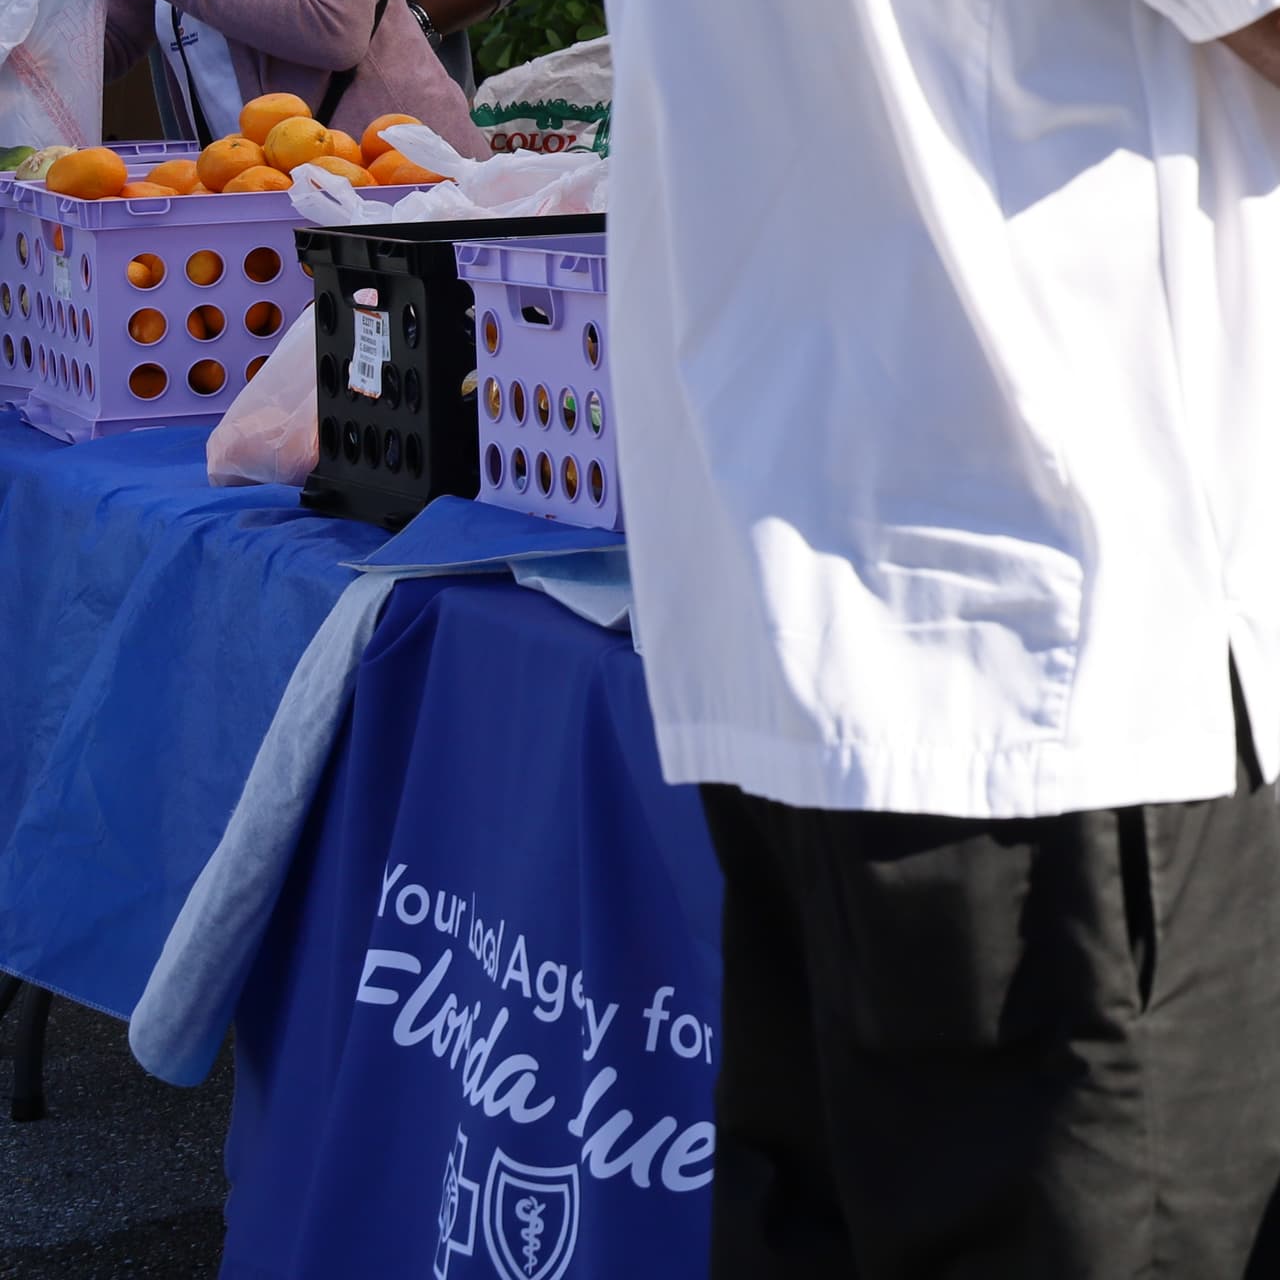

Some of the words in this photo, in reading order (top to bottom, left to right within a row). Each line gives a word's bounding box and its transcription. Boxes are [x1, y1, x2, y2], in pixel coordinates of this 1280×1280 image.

[356, 948, 556, 1124] Florida
[568, 1066, 716, 1192] lue
[378, 861, 467, 939] Your
[469, 891, 505, 982] Local
[643, 985, 713, 1065] for
